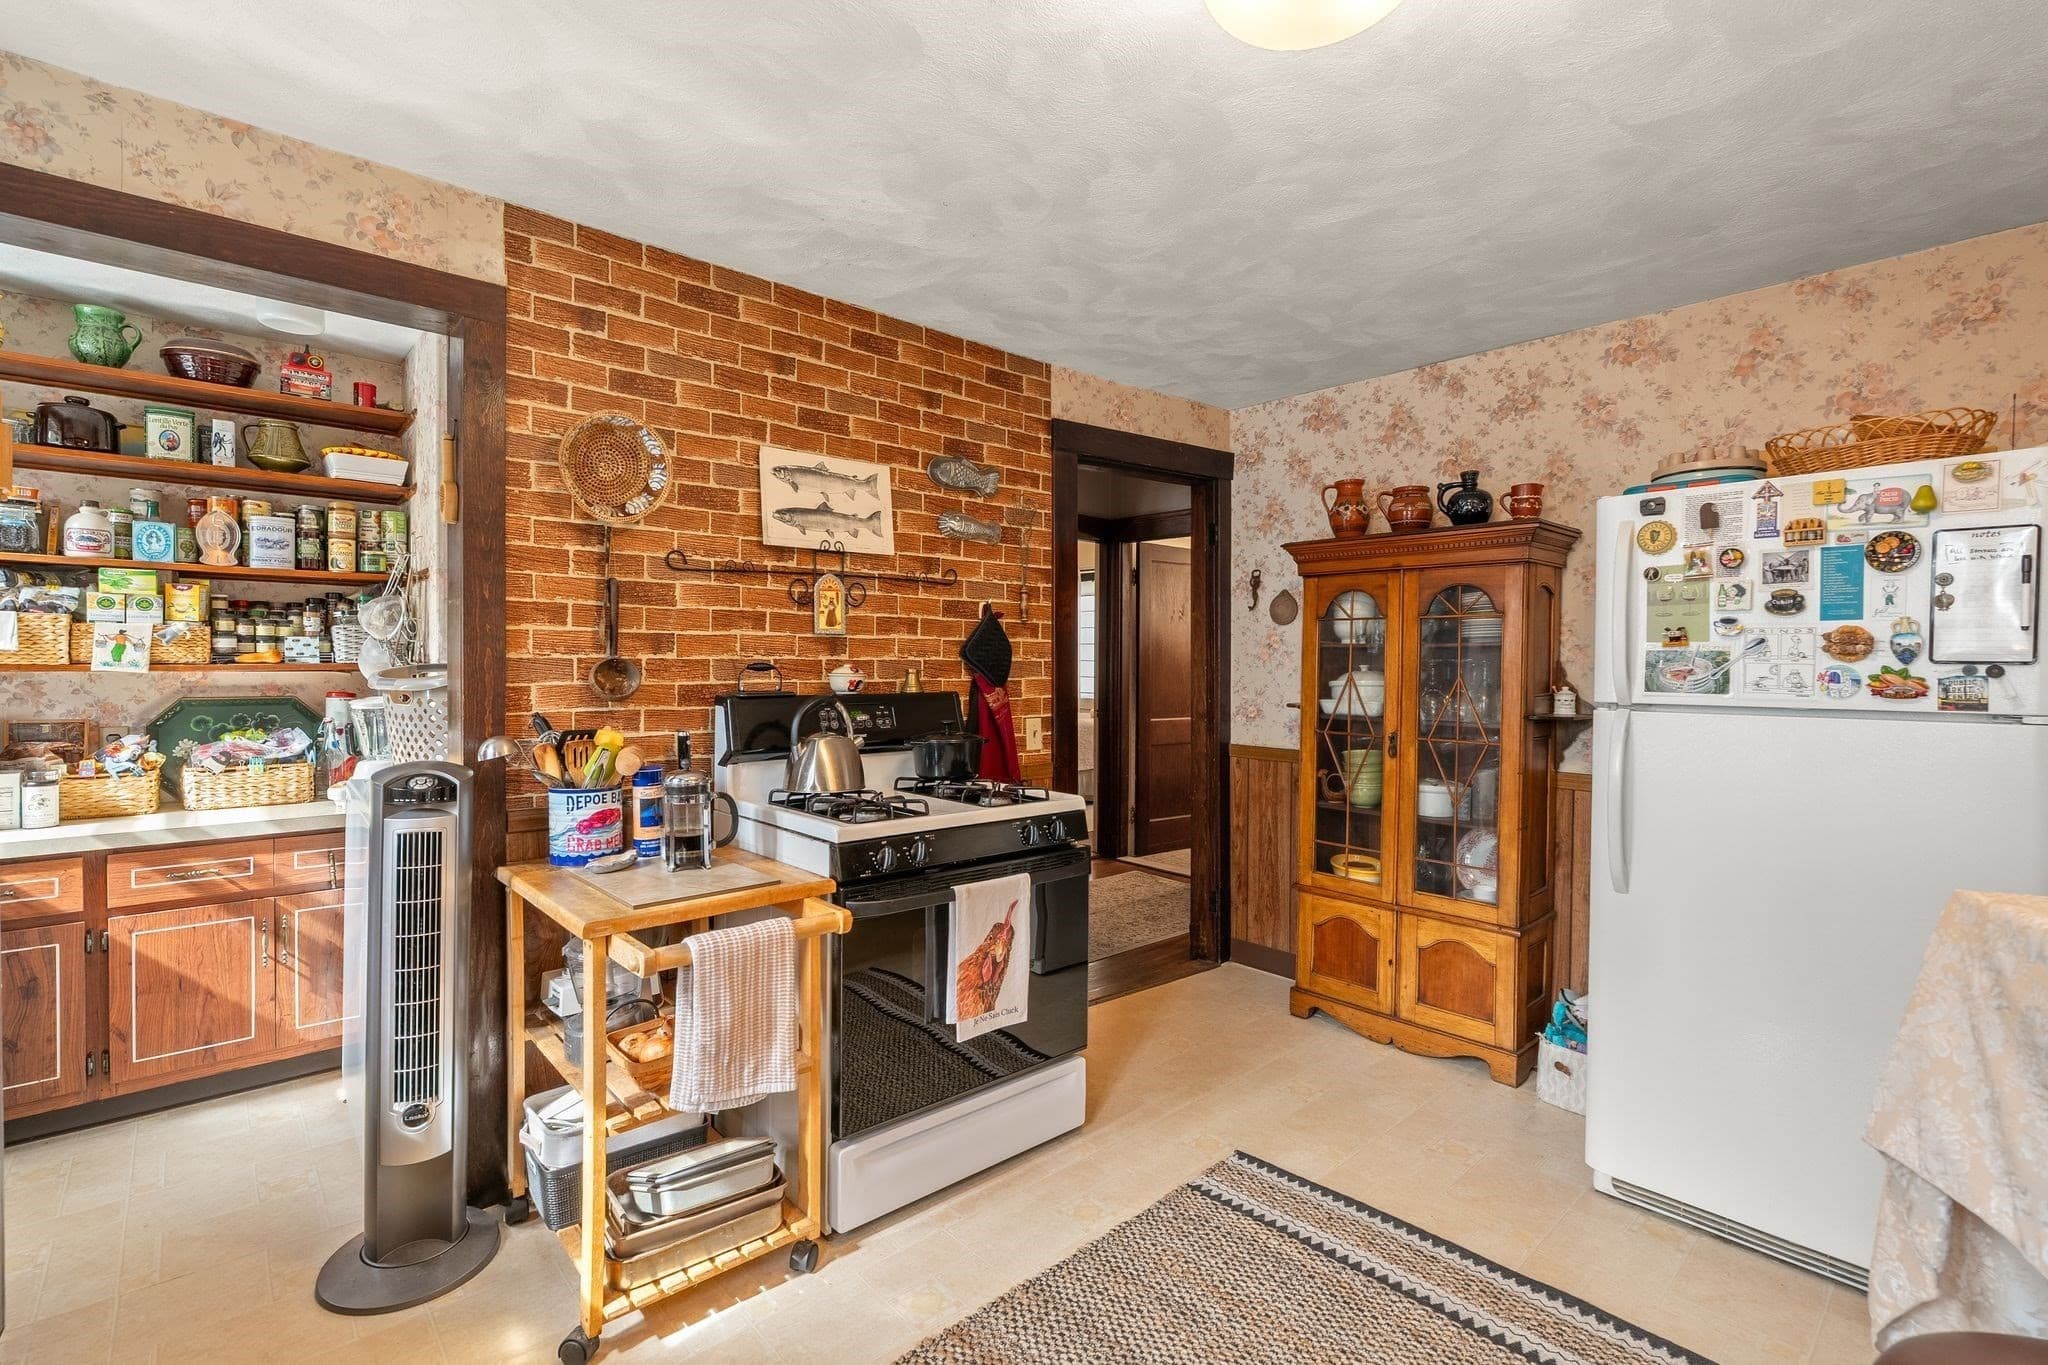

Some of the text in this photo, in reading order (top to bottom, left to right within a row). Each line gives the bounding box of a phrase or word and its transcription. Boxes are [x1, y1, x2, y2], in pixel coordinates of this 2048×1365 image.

[171, 418, 189, 427] Verte
[251, 525, 293, 534] EDRADOUR
[1971, 530, 2000, 538] notes
[566, 793, 607, 814] DEPOE
[567, 834, 602, 852] CRAB
[1000, 1006, 1019, 1017] Cluck
